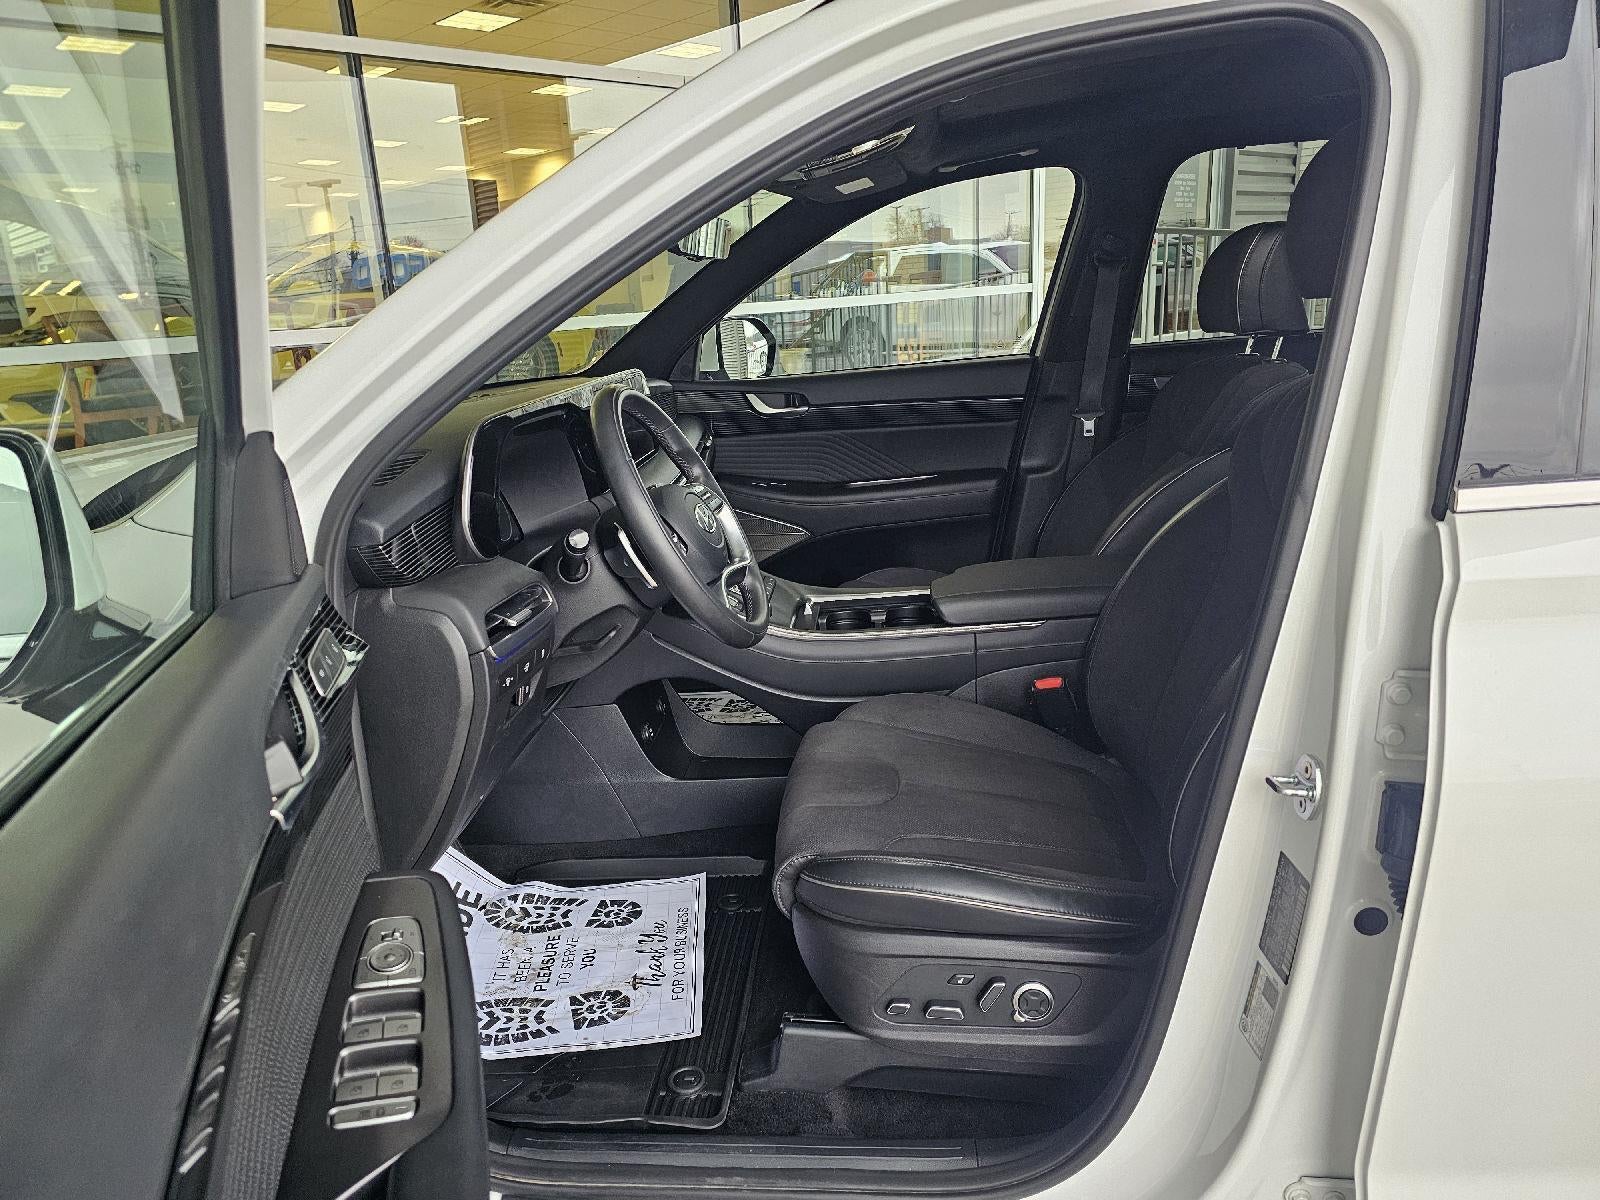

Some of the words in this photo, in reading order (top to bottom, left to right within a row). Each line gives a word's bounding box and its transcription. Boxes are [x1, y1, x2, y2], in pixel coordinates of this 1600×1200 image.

[637, 919, 668, 945] You
[674, 907, 689, 948] BUSINESS
[496, 948, 515, 969] HAS
[533, 934, 561, 992] PLEASURE
[560, 936, 581, 969] SERVE
[580, 948, 597, 971] YOU
[672, 948, 686, 977] YOUR
[513, 956, 534, 983] BEEN
[555, 972, 572, 986] TO
[631, 945, 668, 991] Thank
[671, 979, 685, 1001] FOR
